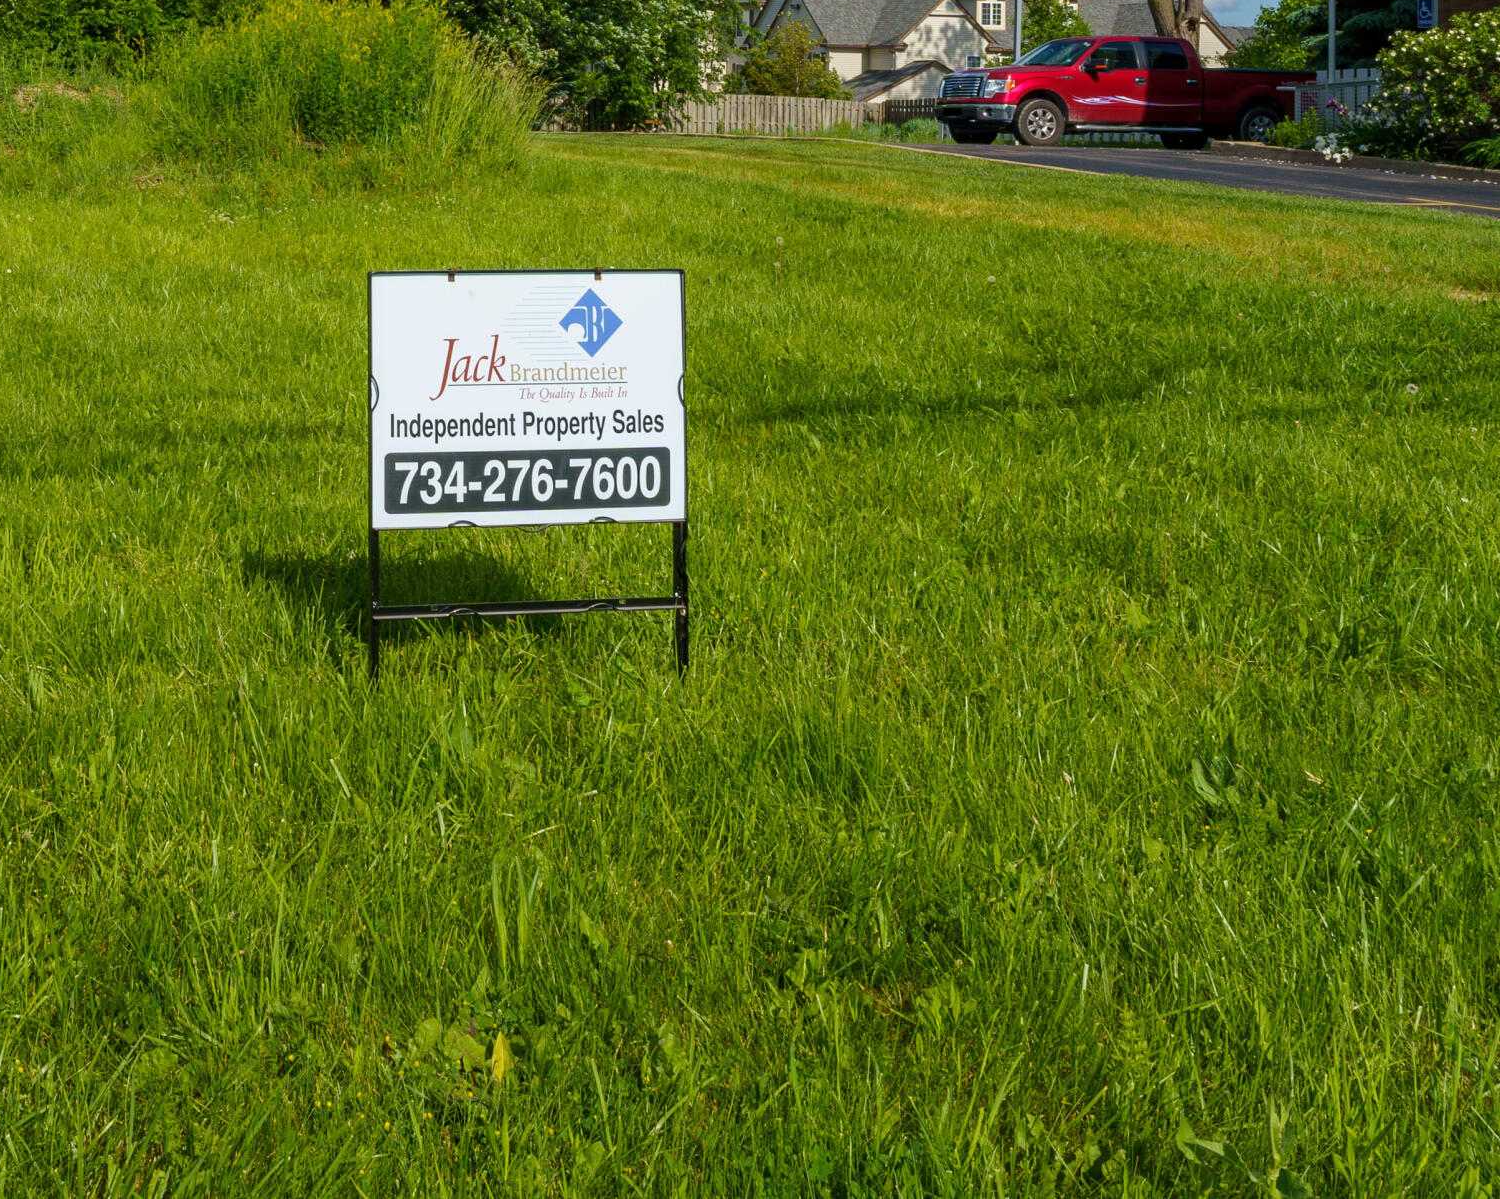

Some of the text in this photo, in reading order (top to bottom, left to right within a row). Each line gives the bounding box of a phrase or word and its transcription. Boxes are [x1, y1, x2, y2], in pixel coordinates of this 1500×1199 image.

[429, 333, 628, 401] Jack Brandmeier
[519, 385, 628, 404] The Quality Is Built In
[390, 409, 664, 444] Independent Property Sales
[395, 455, 661, 505] 734-276-7600
